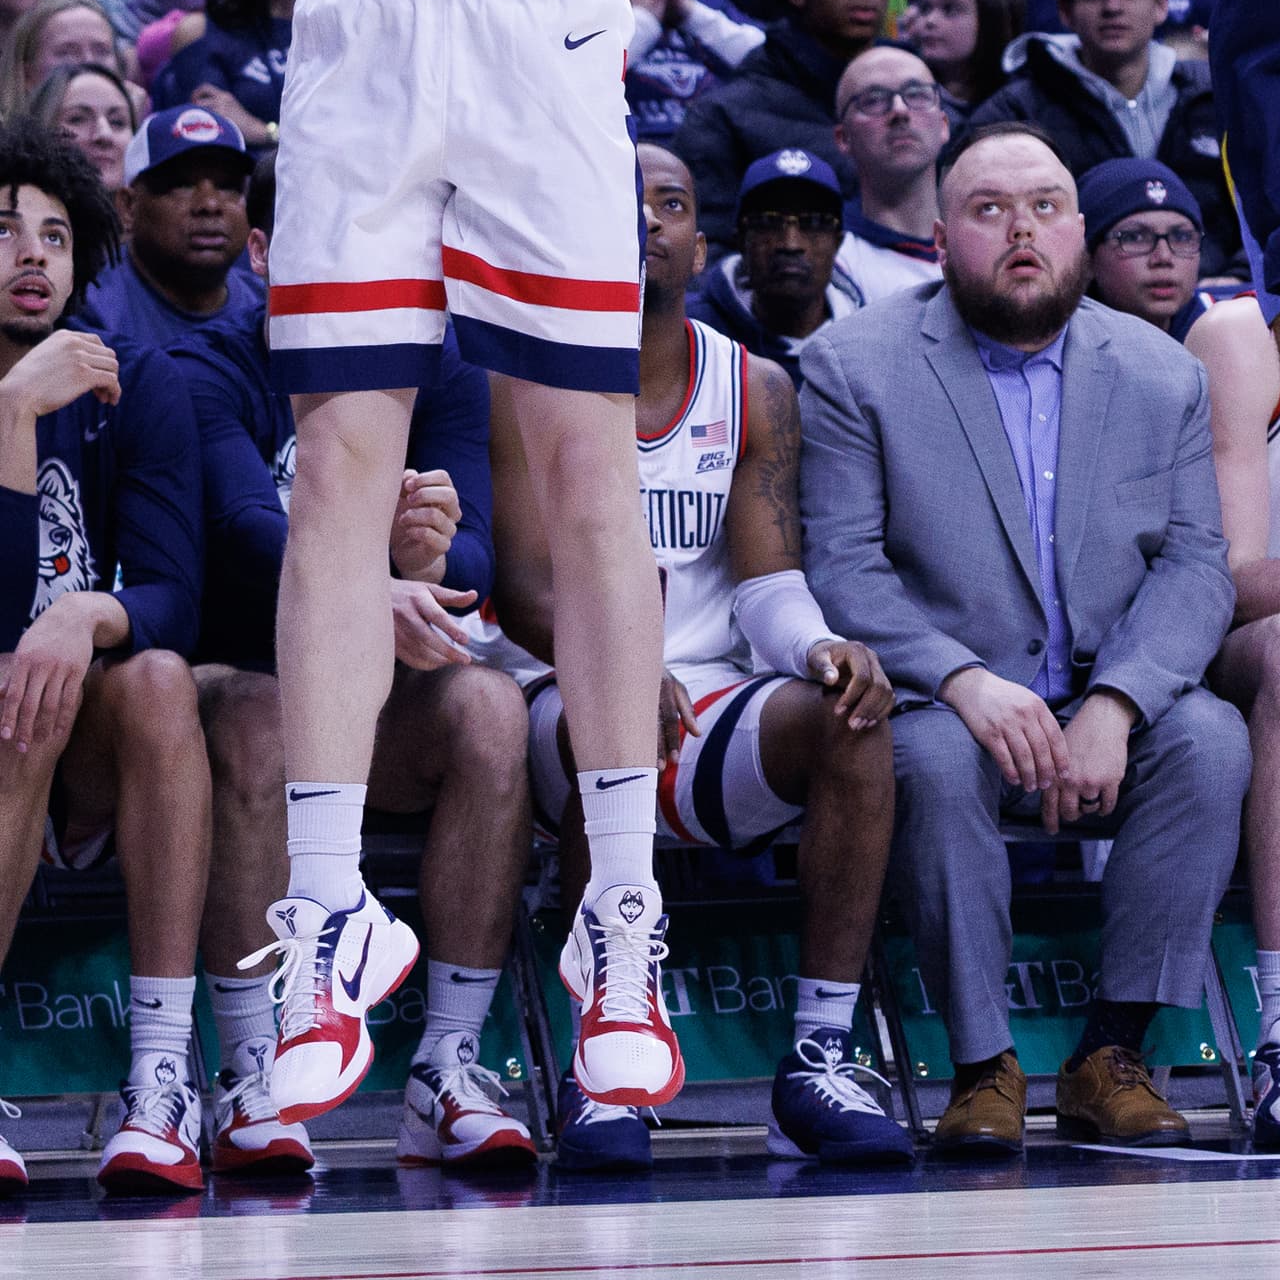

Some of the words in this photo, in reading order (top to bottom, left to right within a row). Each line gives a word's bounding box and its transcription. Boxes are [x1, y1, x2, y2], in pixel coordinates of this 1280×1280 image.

[696, 457, 734, 471] EAST
[700, 451, 726, 463] BIG
[706, 965, 800, 1014] Ban
